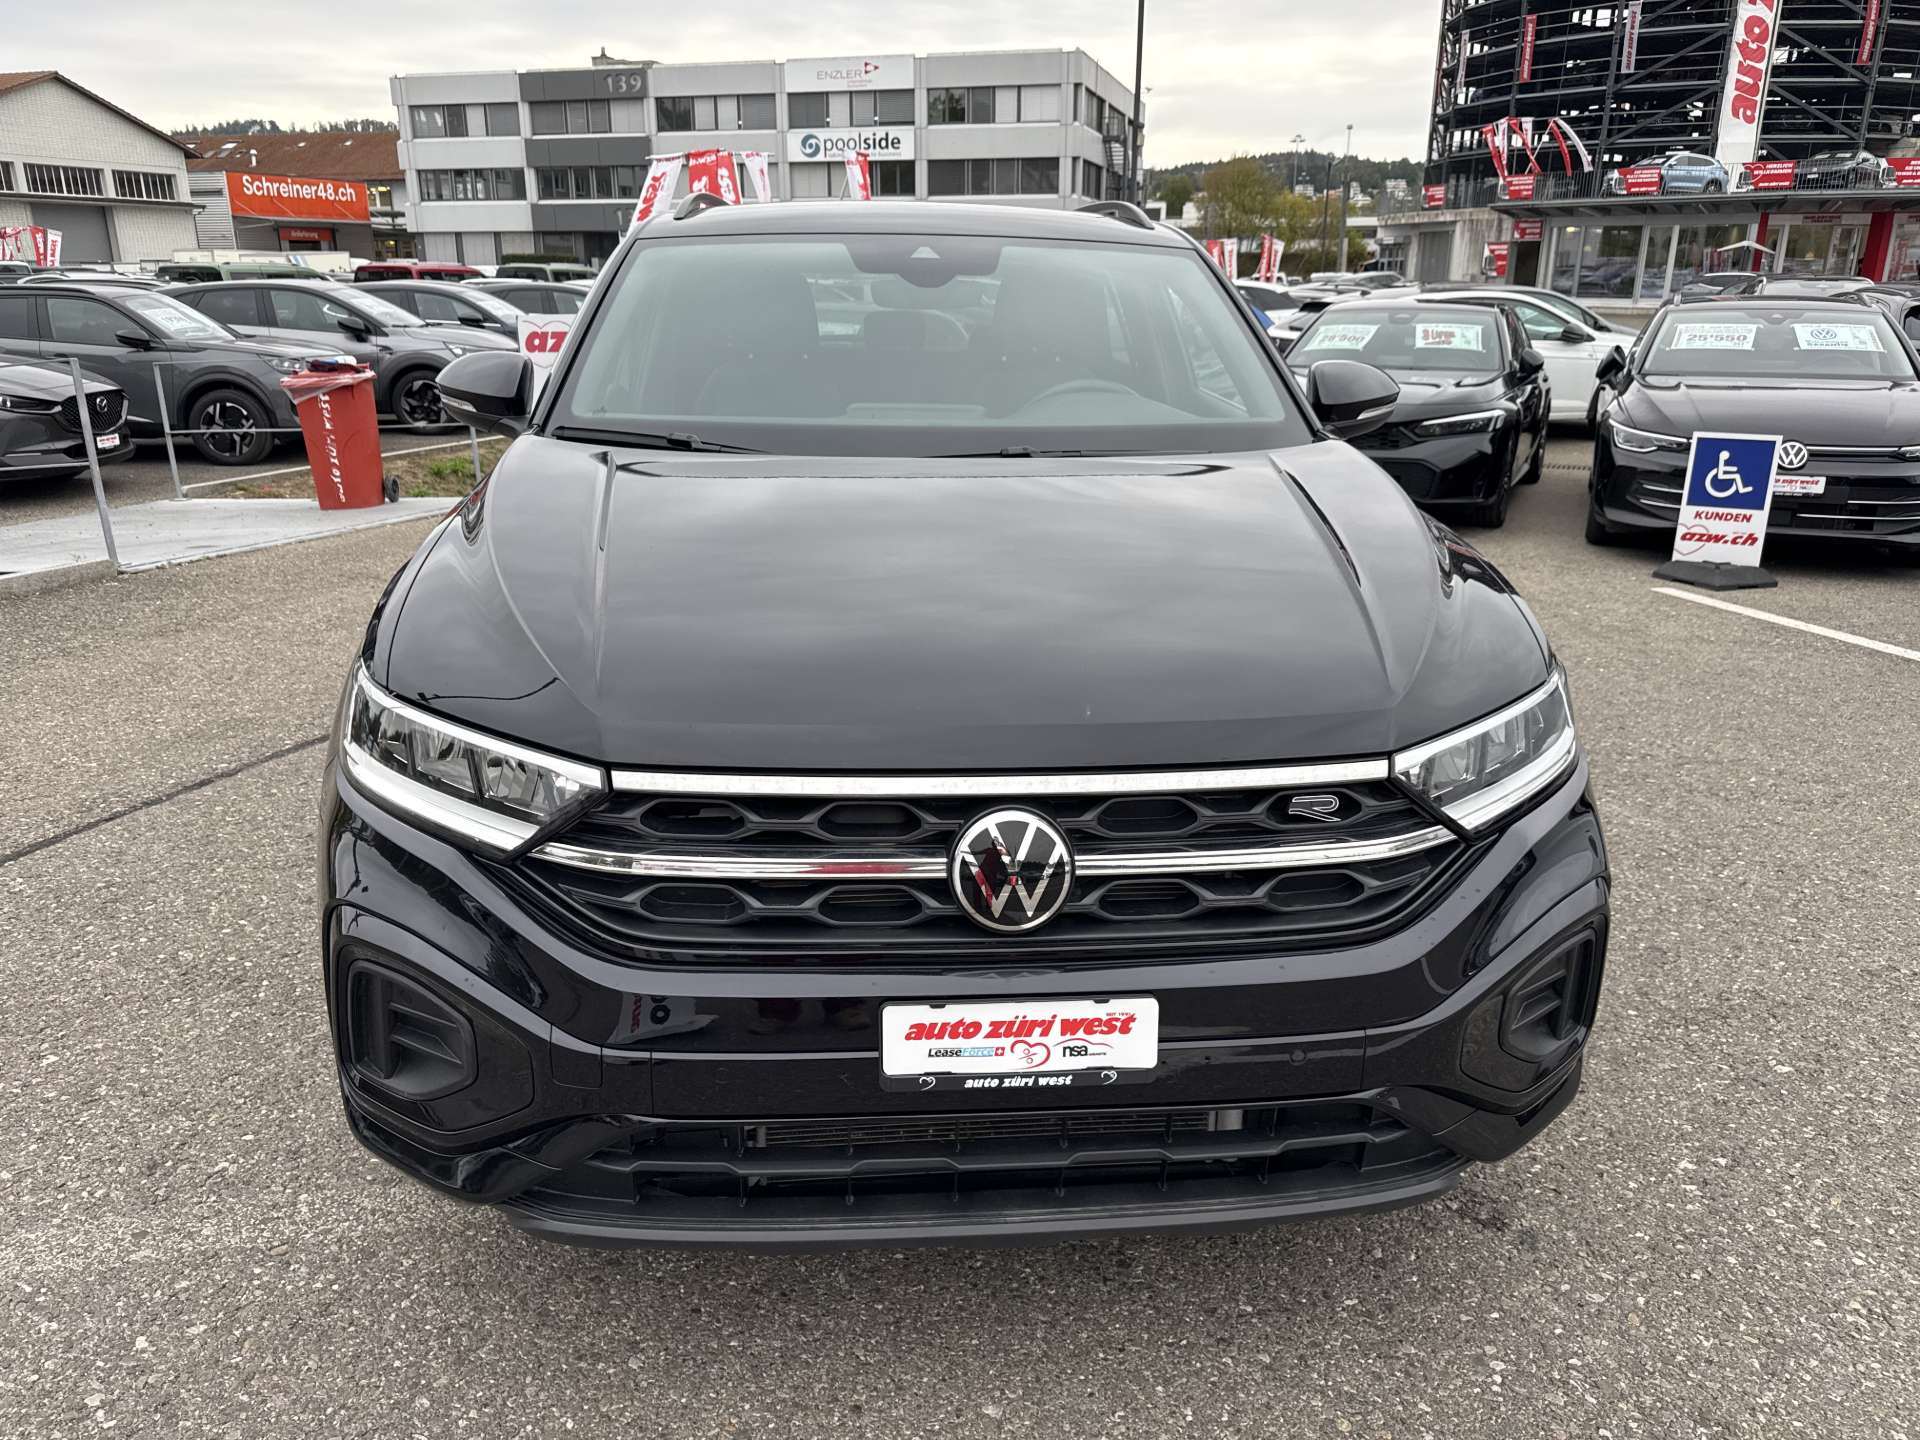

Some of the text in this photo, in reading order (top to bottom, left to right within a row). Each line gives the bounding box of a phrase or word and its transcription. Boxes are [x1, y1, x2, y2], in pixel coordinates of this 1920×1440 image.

[816, 69, 863, 80] ENZLER
[1731, 14, 1770, 125] auto
[606, 74, 642, 93] 139
[823, 131, 901, 158] poolside
[242, 175, 357, 202] Schreiner48.ch
[1694, 510, 1753, 523] KUNDEN
[1680, 531, 1759, 546] azw.ch
[904, 1013, 1137, 1041] auto züri west
[928, 1047, 994, 1058] LeaseForce
[1062, 1045, 1088, 1057] nsa
[964, 1074, 1073, 1088] auto züri west
